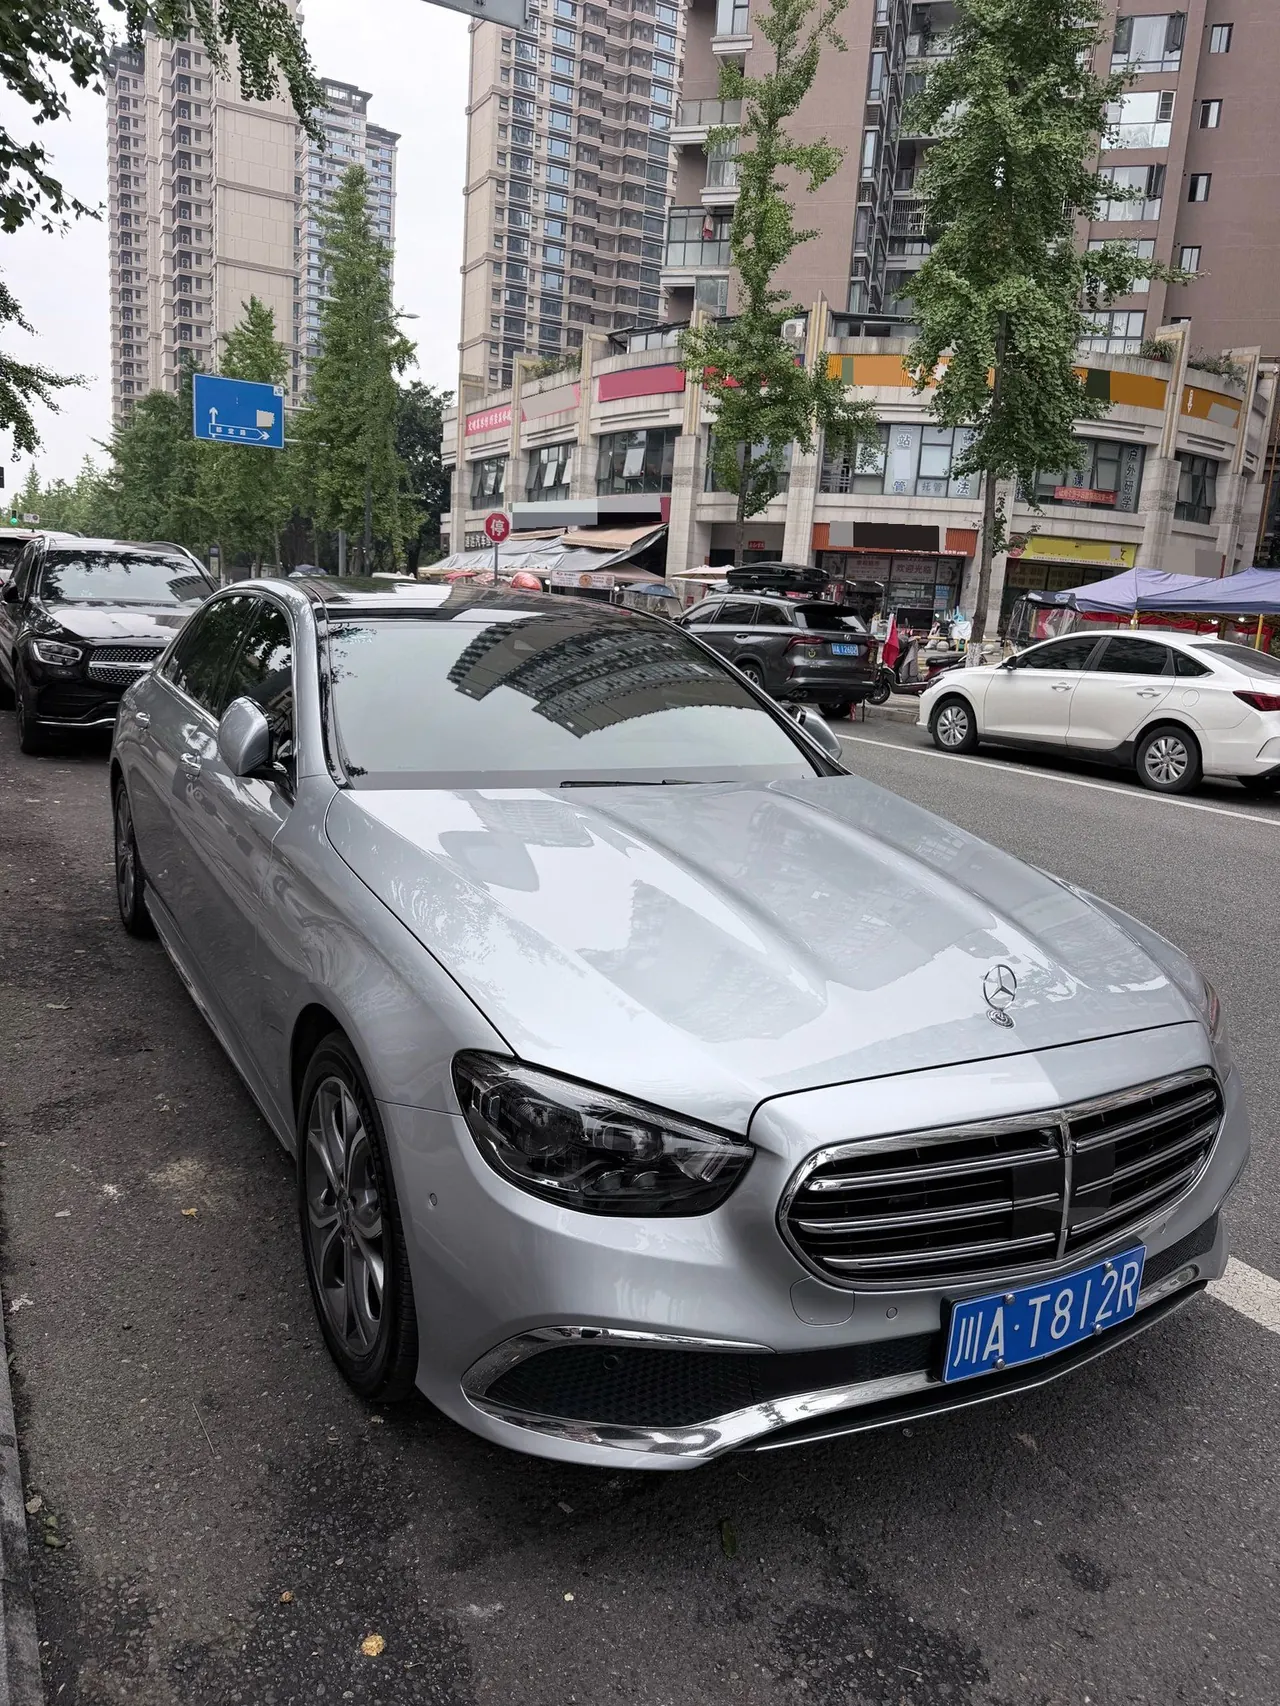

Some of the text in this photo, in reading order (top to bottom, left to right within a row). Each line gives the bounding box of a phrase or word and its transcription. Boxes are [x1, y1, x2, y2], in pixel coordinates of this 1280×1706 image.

[1120, 448, 1138, 510] 户外研学
[921, 481, 943, 493] 托管
[490, 519, 505, 537] 停
[896, 563, 933, 575] 欢迎光临
